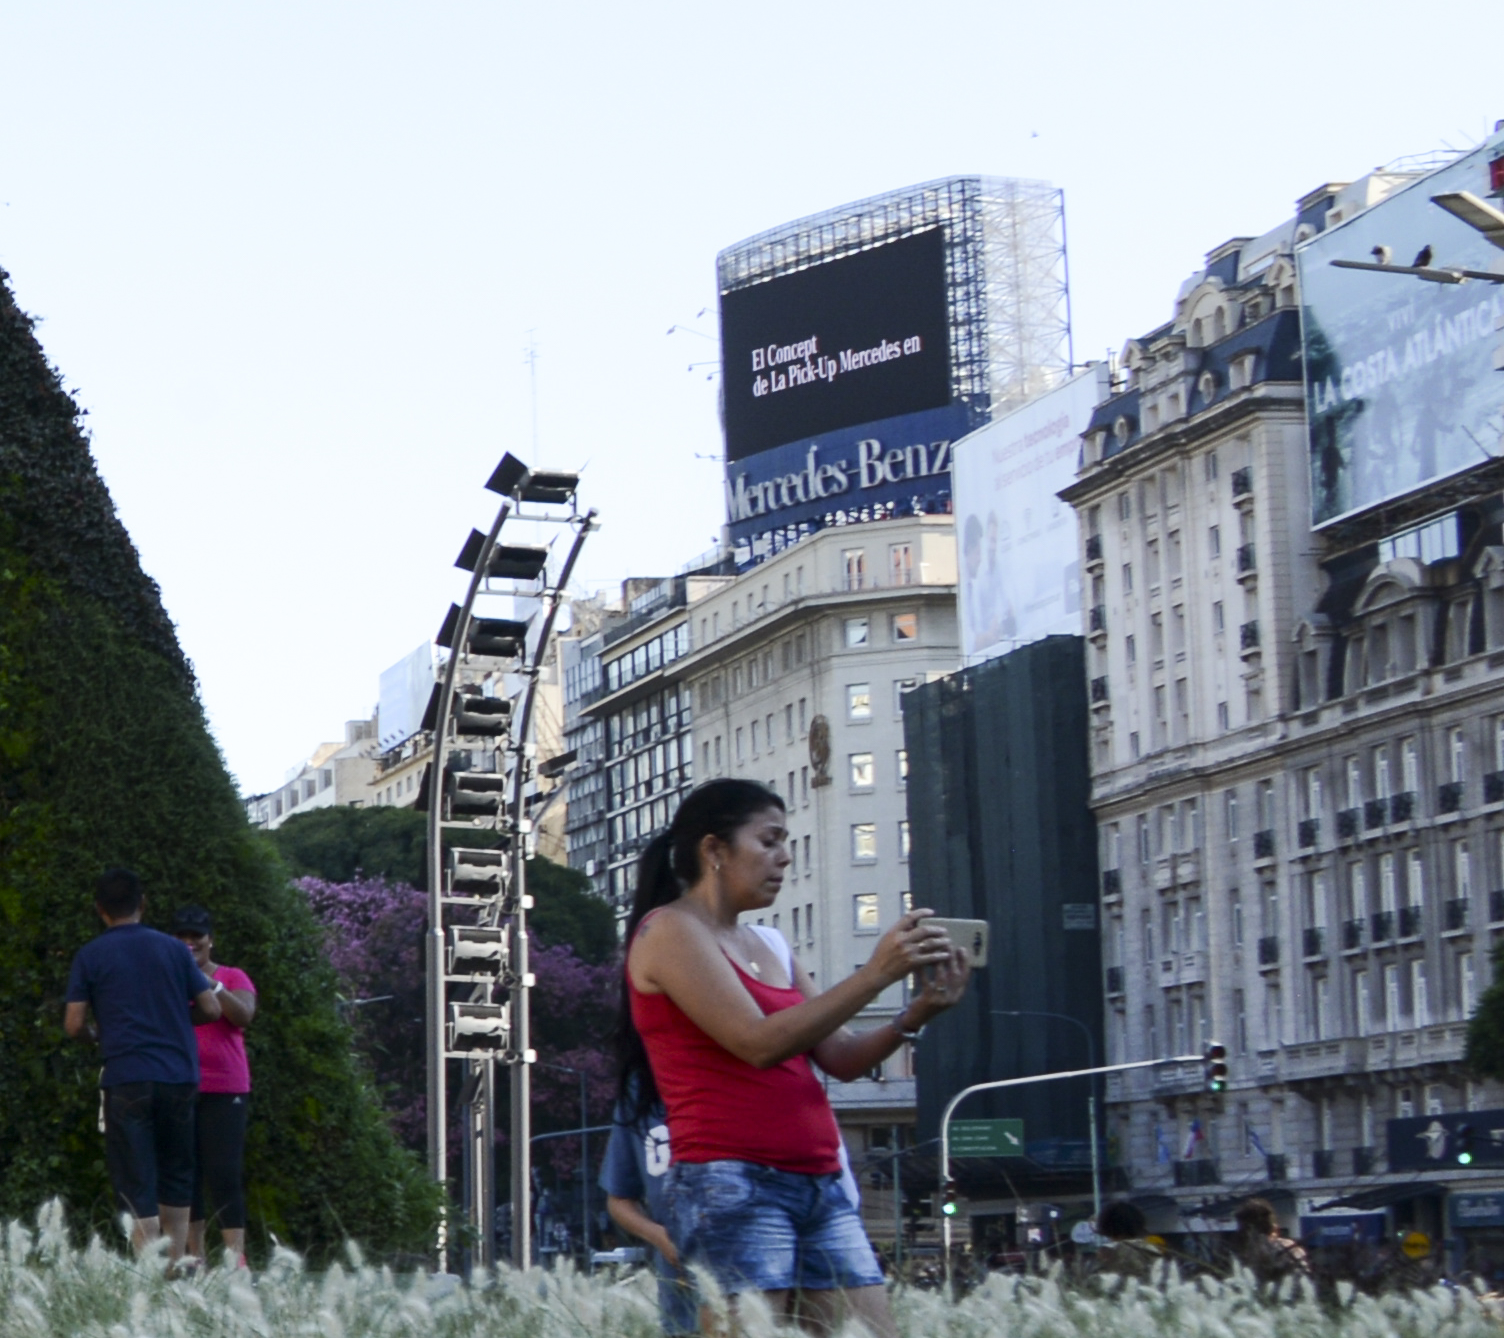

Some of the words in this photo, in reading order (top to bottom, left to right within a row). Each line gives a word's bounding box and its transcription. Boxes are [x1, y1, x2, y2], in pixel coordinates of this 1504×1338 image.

[751, 348, 765, 372] El
[768, 335, 819, 367] Concept
[752, 375, 769, 398] de
[770, 369, 787, 393] La
[788, 356, 838, 387] Pick-Up
[839, 339, 902, 374] Mercedes
[903, 335, 922, 356] en
[1313, 375, 1337, 413] LA
[1340, 345, 1399, 400] COSTA
[725, 438, 954, 522] Mercedes-Benz
